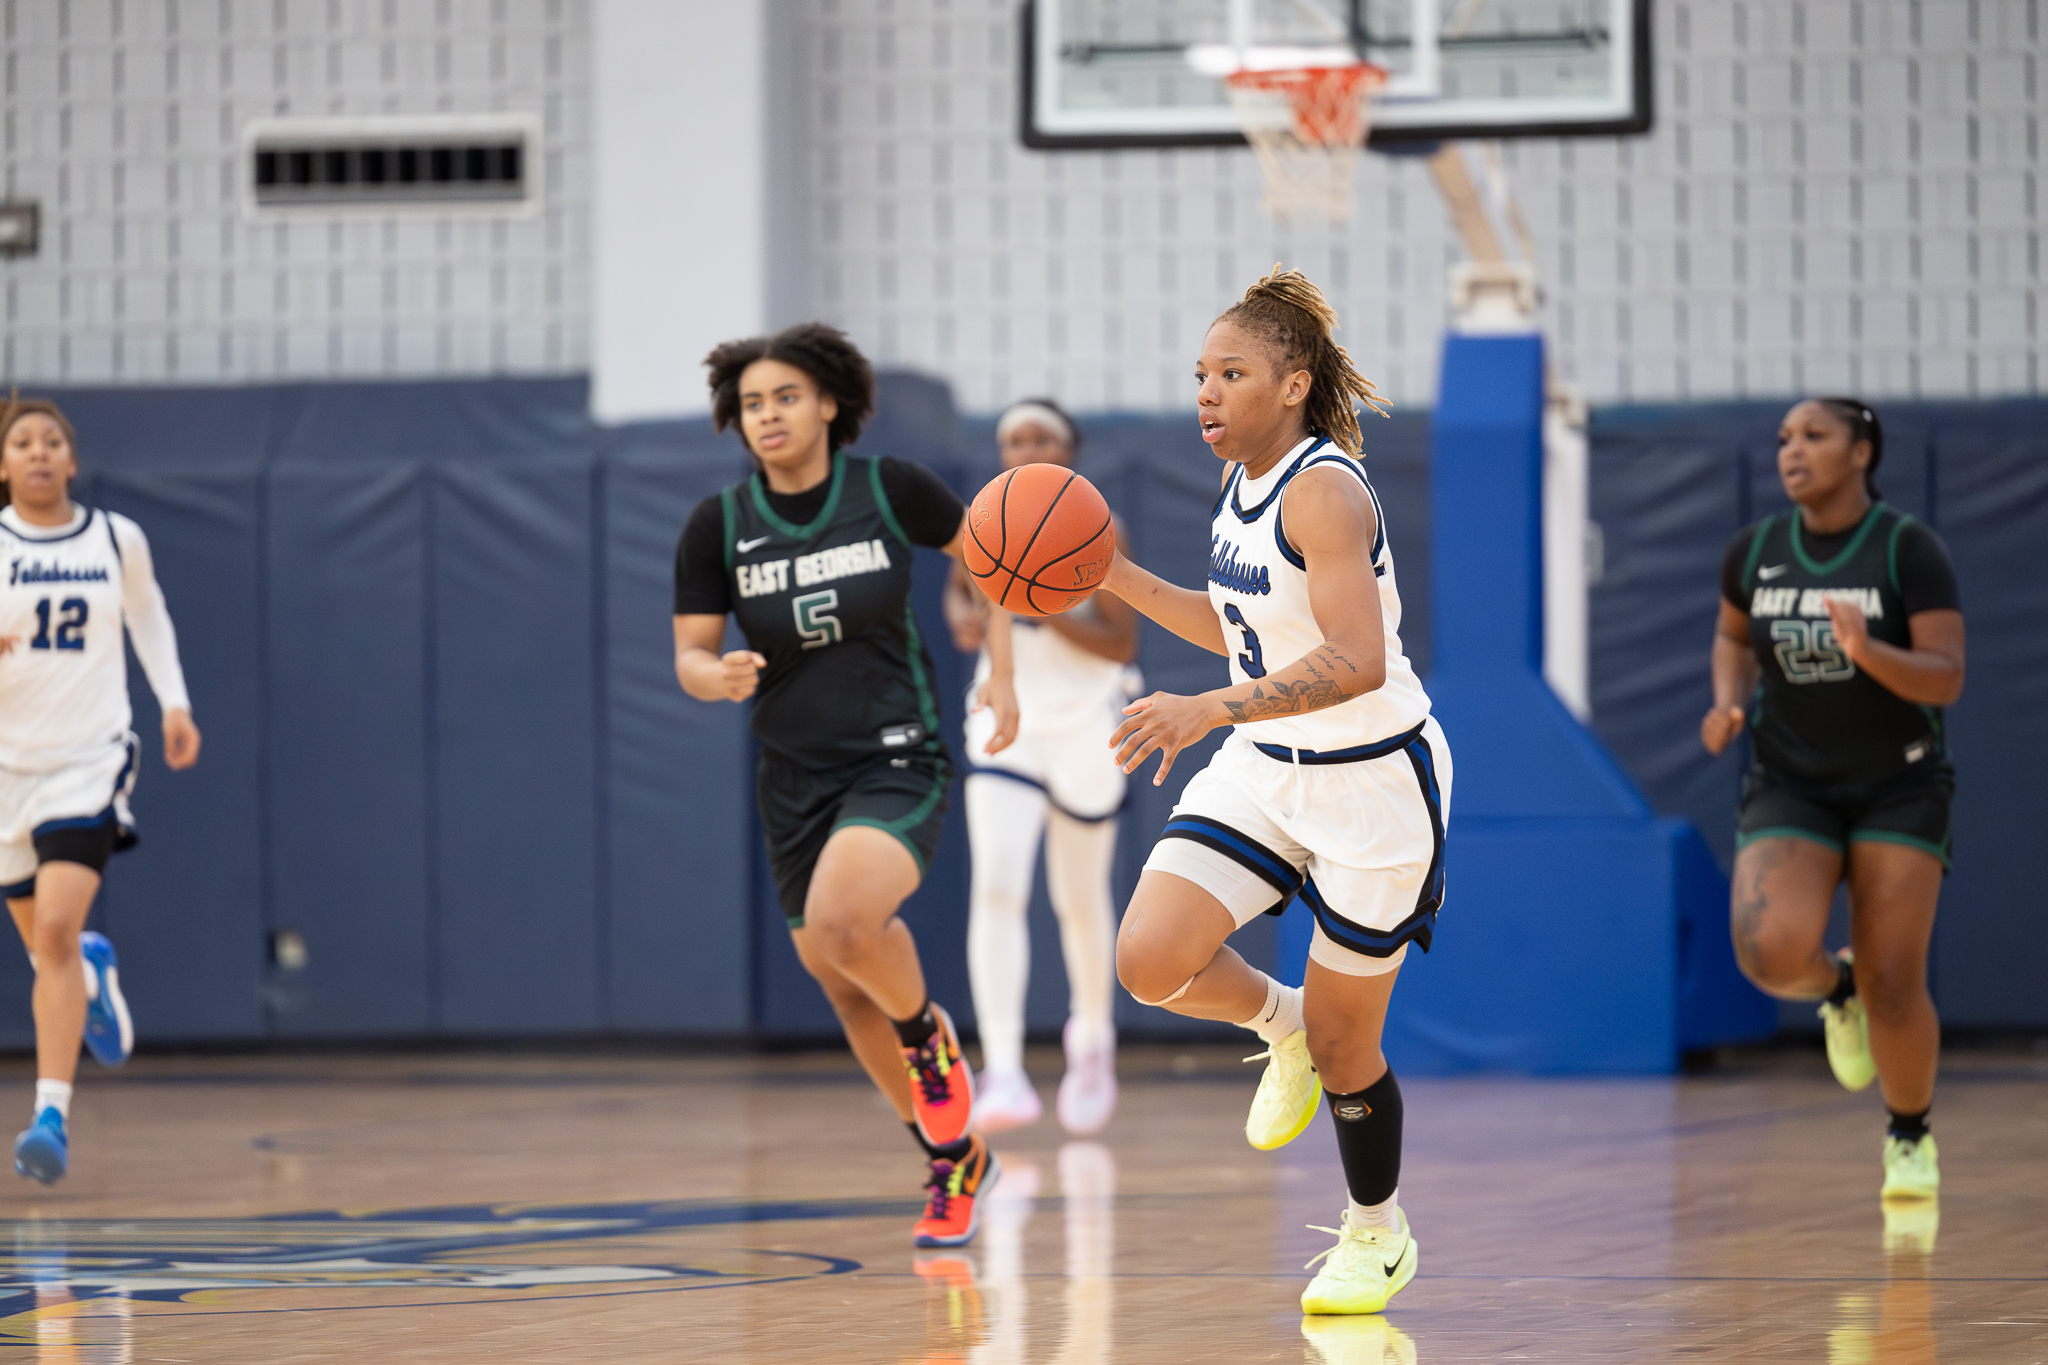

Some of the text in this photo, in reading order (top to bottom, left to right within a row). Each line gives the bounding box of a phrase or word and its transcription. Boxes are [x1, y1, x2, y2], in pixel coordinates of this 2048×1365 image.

[736, 539, 892, 598] EAST GEORGIA
[31, 598, 88, 650] 12
[792, 589, 843, 651] 5
[1751, 587, 1799, 618] EAST
[1224, 602, 1267, 679] 3
[1770, 620, 1856, 685] 25
